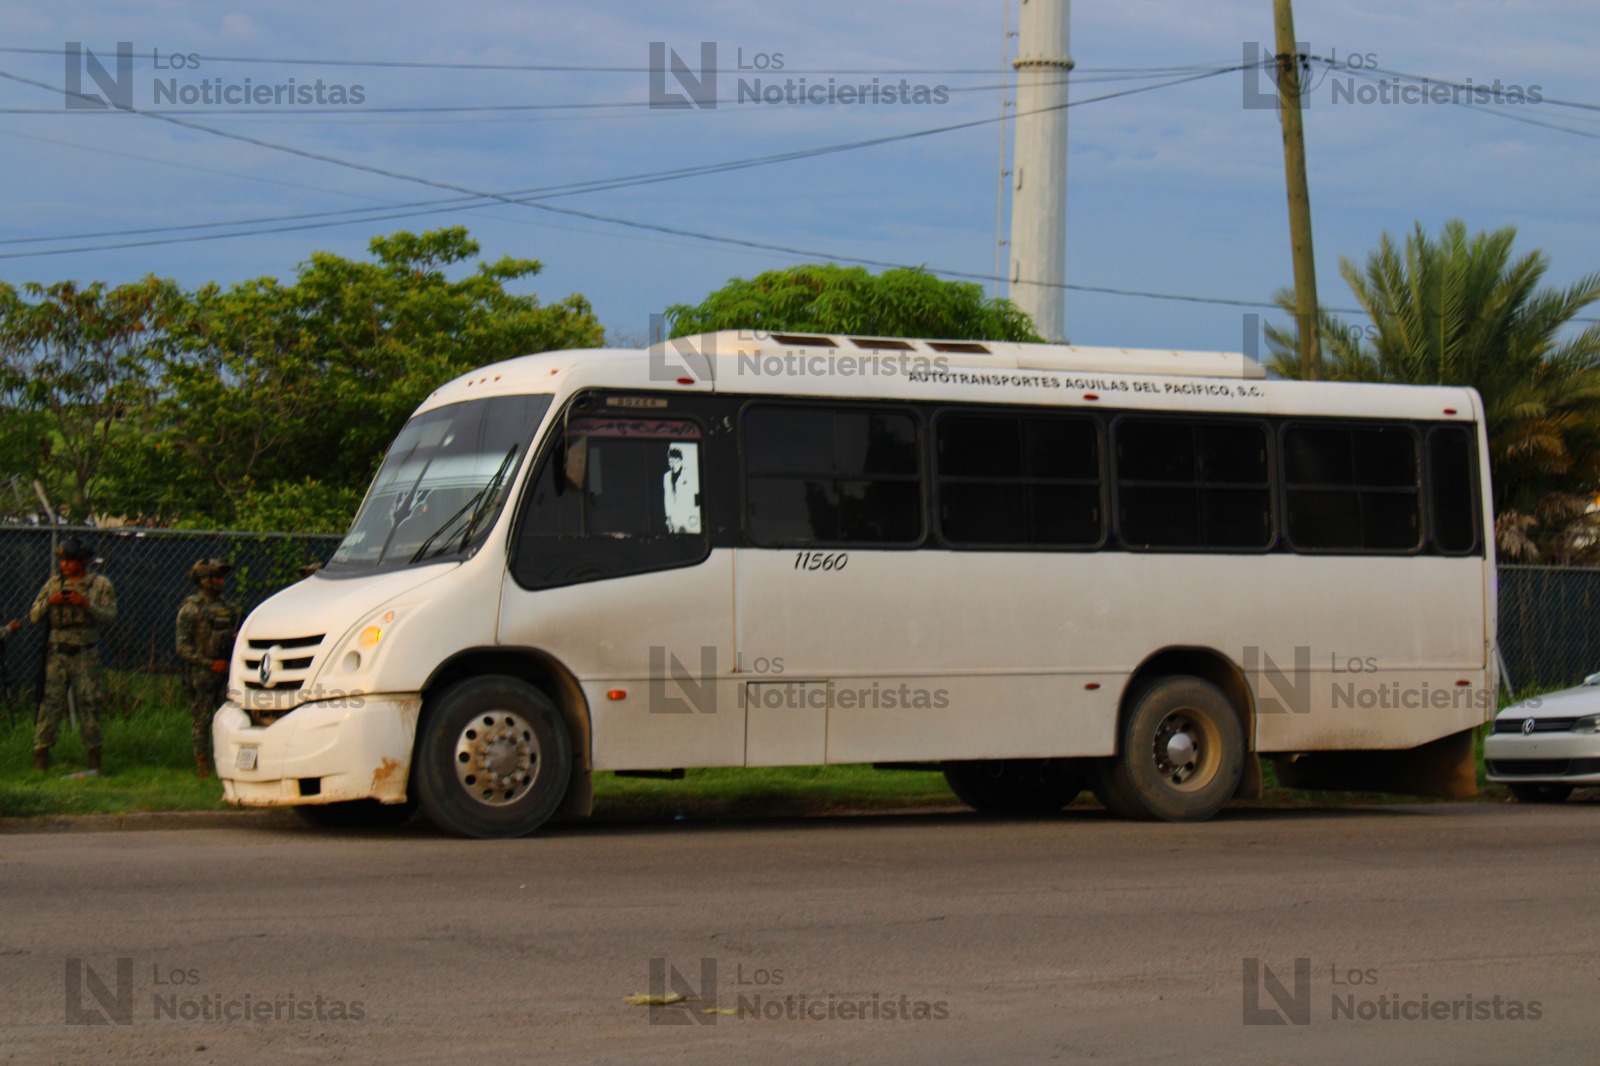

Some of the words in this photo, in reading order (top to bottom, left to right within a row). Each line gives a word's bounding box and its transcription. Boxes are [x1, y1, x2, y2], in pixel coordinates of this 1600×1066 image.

[909, 371, 1060, 388] AUTOTRANSPORTES
[1065, 378, 1129, 391] AGUILAS
[1133, 382, 1160, 393] DEL
[1237, 386, 1264, 397] S.C.
[794, 552, 848, 571] 11560
